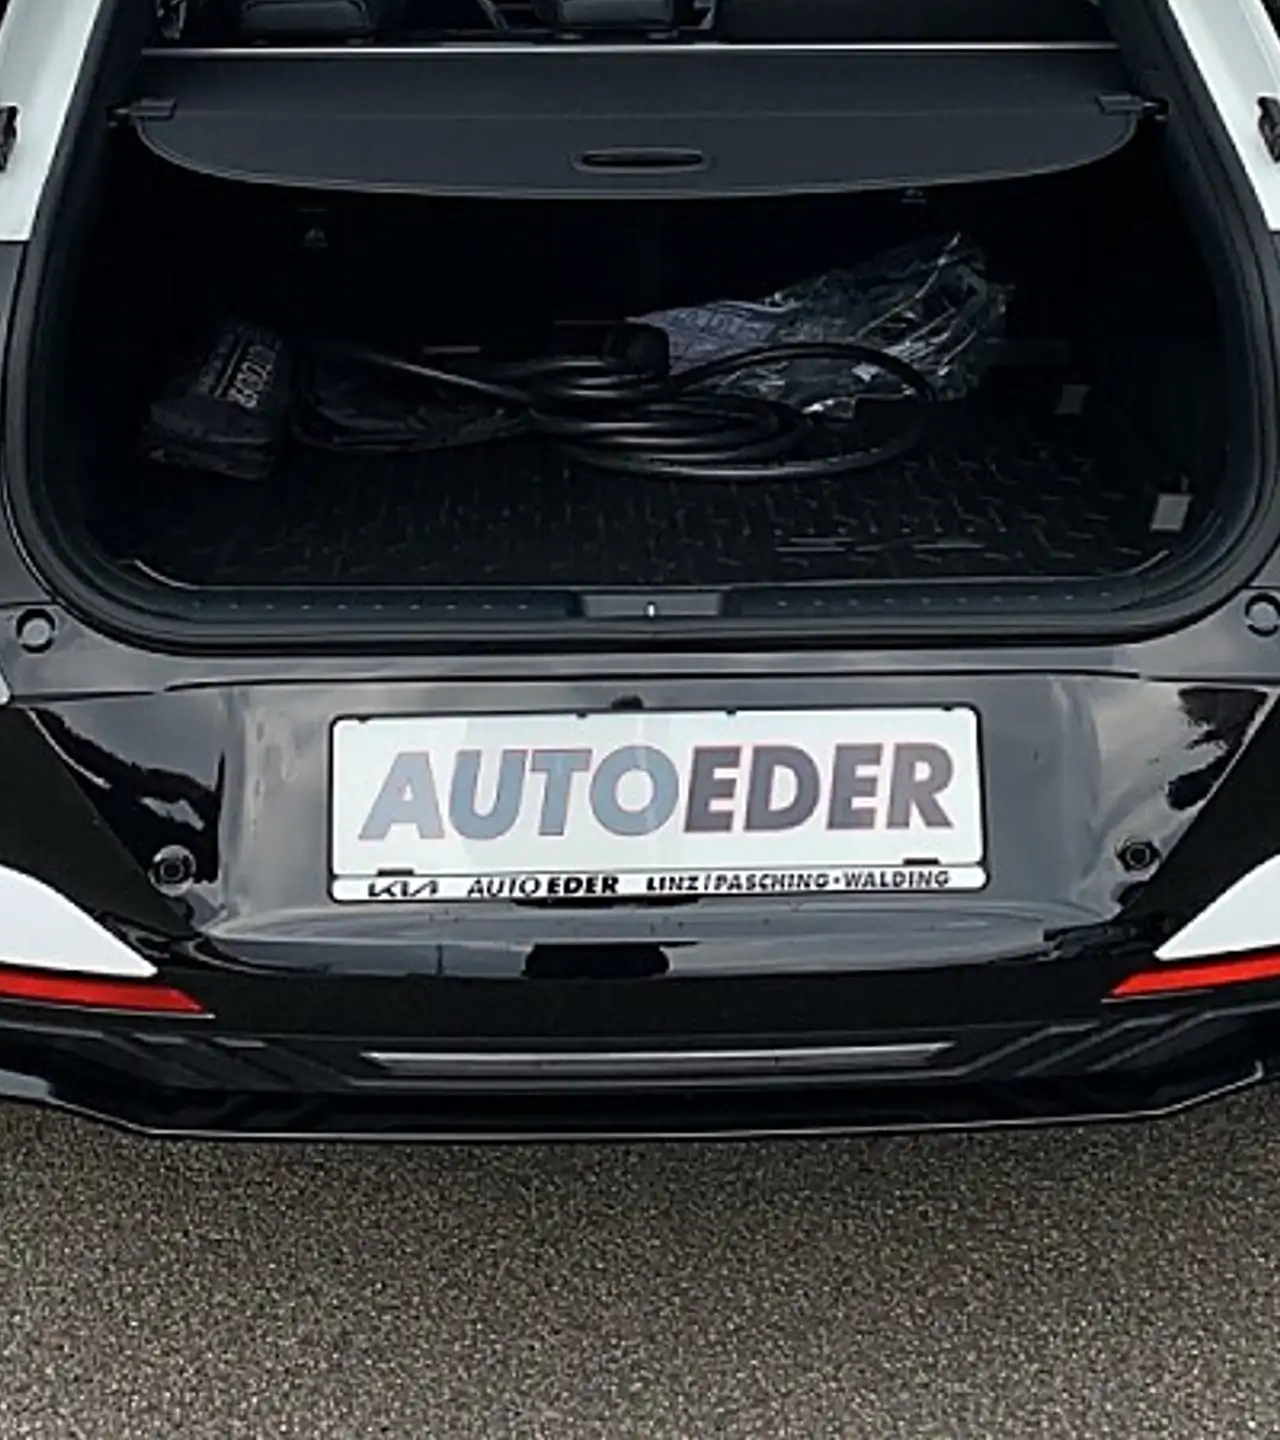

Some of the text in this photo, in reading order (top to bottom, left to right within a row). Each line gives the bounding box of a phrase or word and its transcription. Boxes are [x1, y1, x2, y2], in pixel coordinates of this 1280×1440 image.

[359, 742, 955, 840] AUTOEDER
[368, 880, 438, 897] KIA
[467, 876, 542, 897] AUTO
[547, 875, 620, 895] EDER
